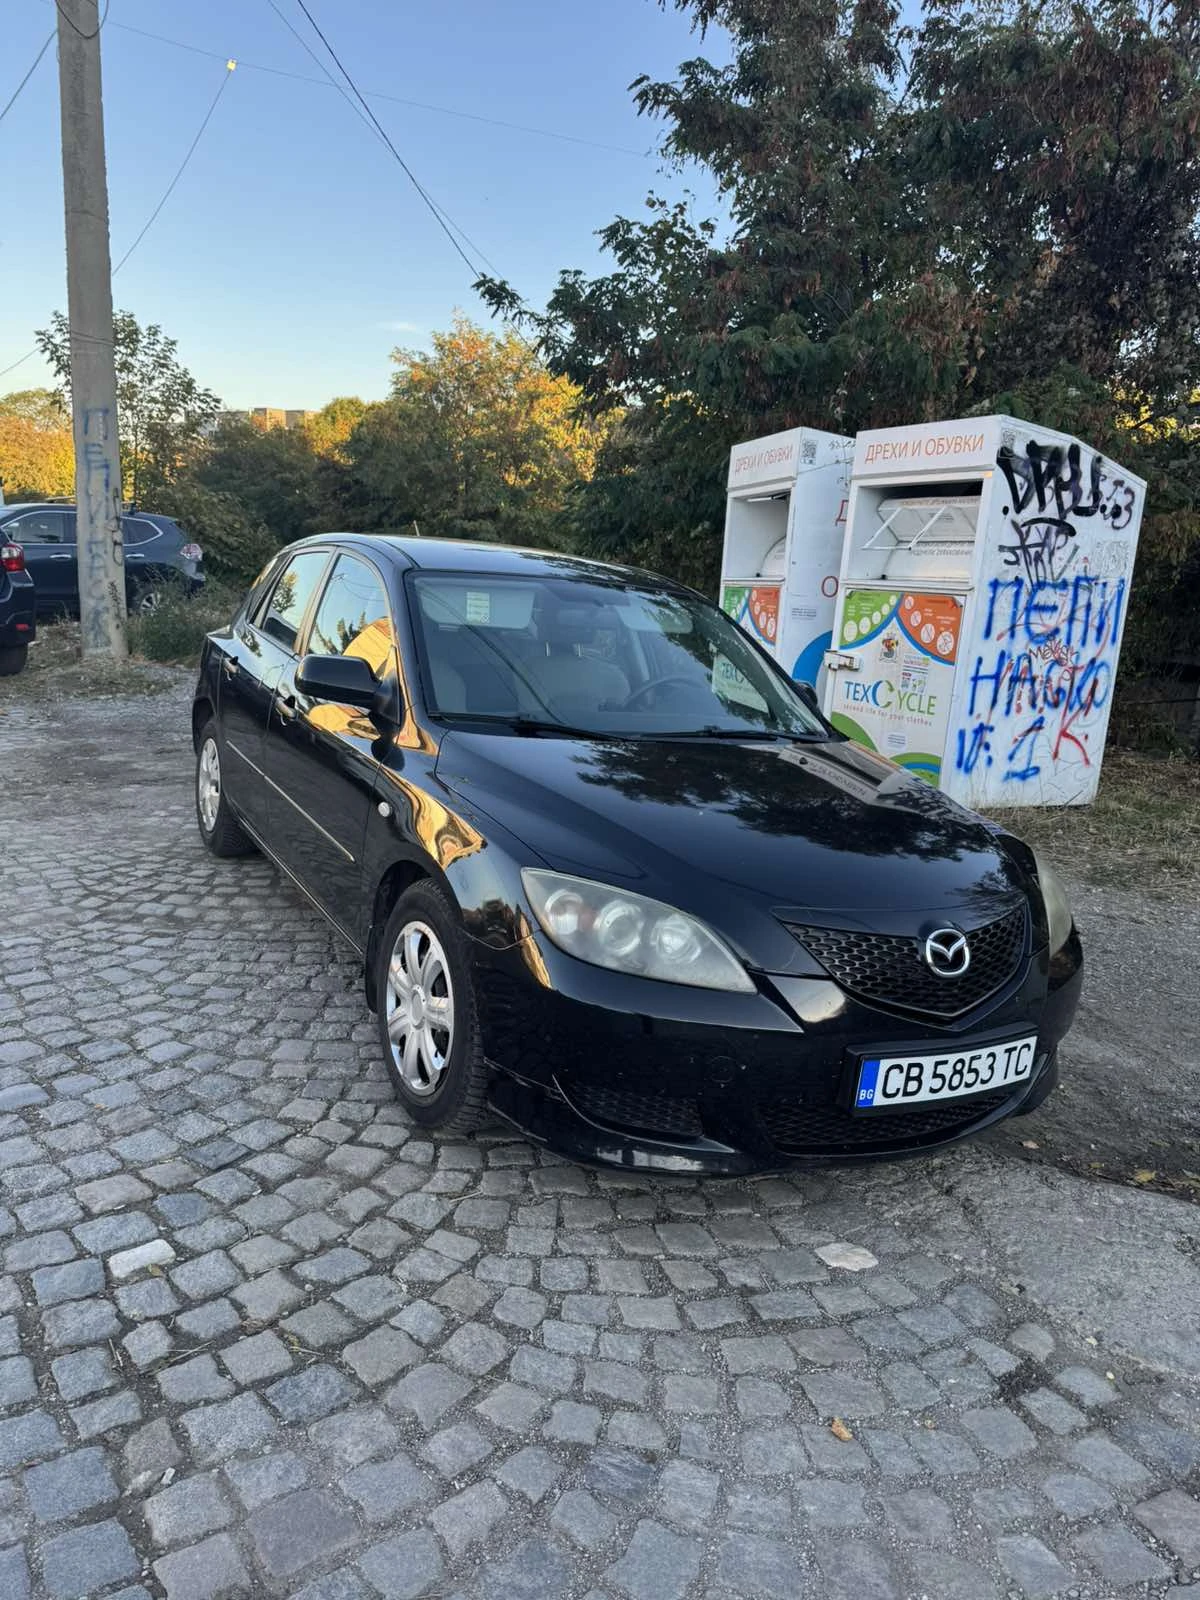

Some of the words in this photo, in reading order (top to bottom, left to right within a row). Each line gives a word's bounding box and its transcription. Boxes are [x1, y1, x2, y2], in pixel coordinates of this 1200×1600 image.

[864, 441, 909, 465] ДРЕХИ
[910, 439, 922, 457] И
[924, 433, 985, 457] ОБУВКИ
[882, 1062, 924, 1099] CB
[929, 1051, 997, 1094] 5853
[1003, 1043, 1031, 1080] TC
[859, 1088, 874, 1101] BG
